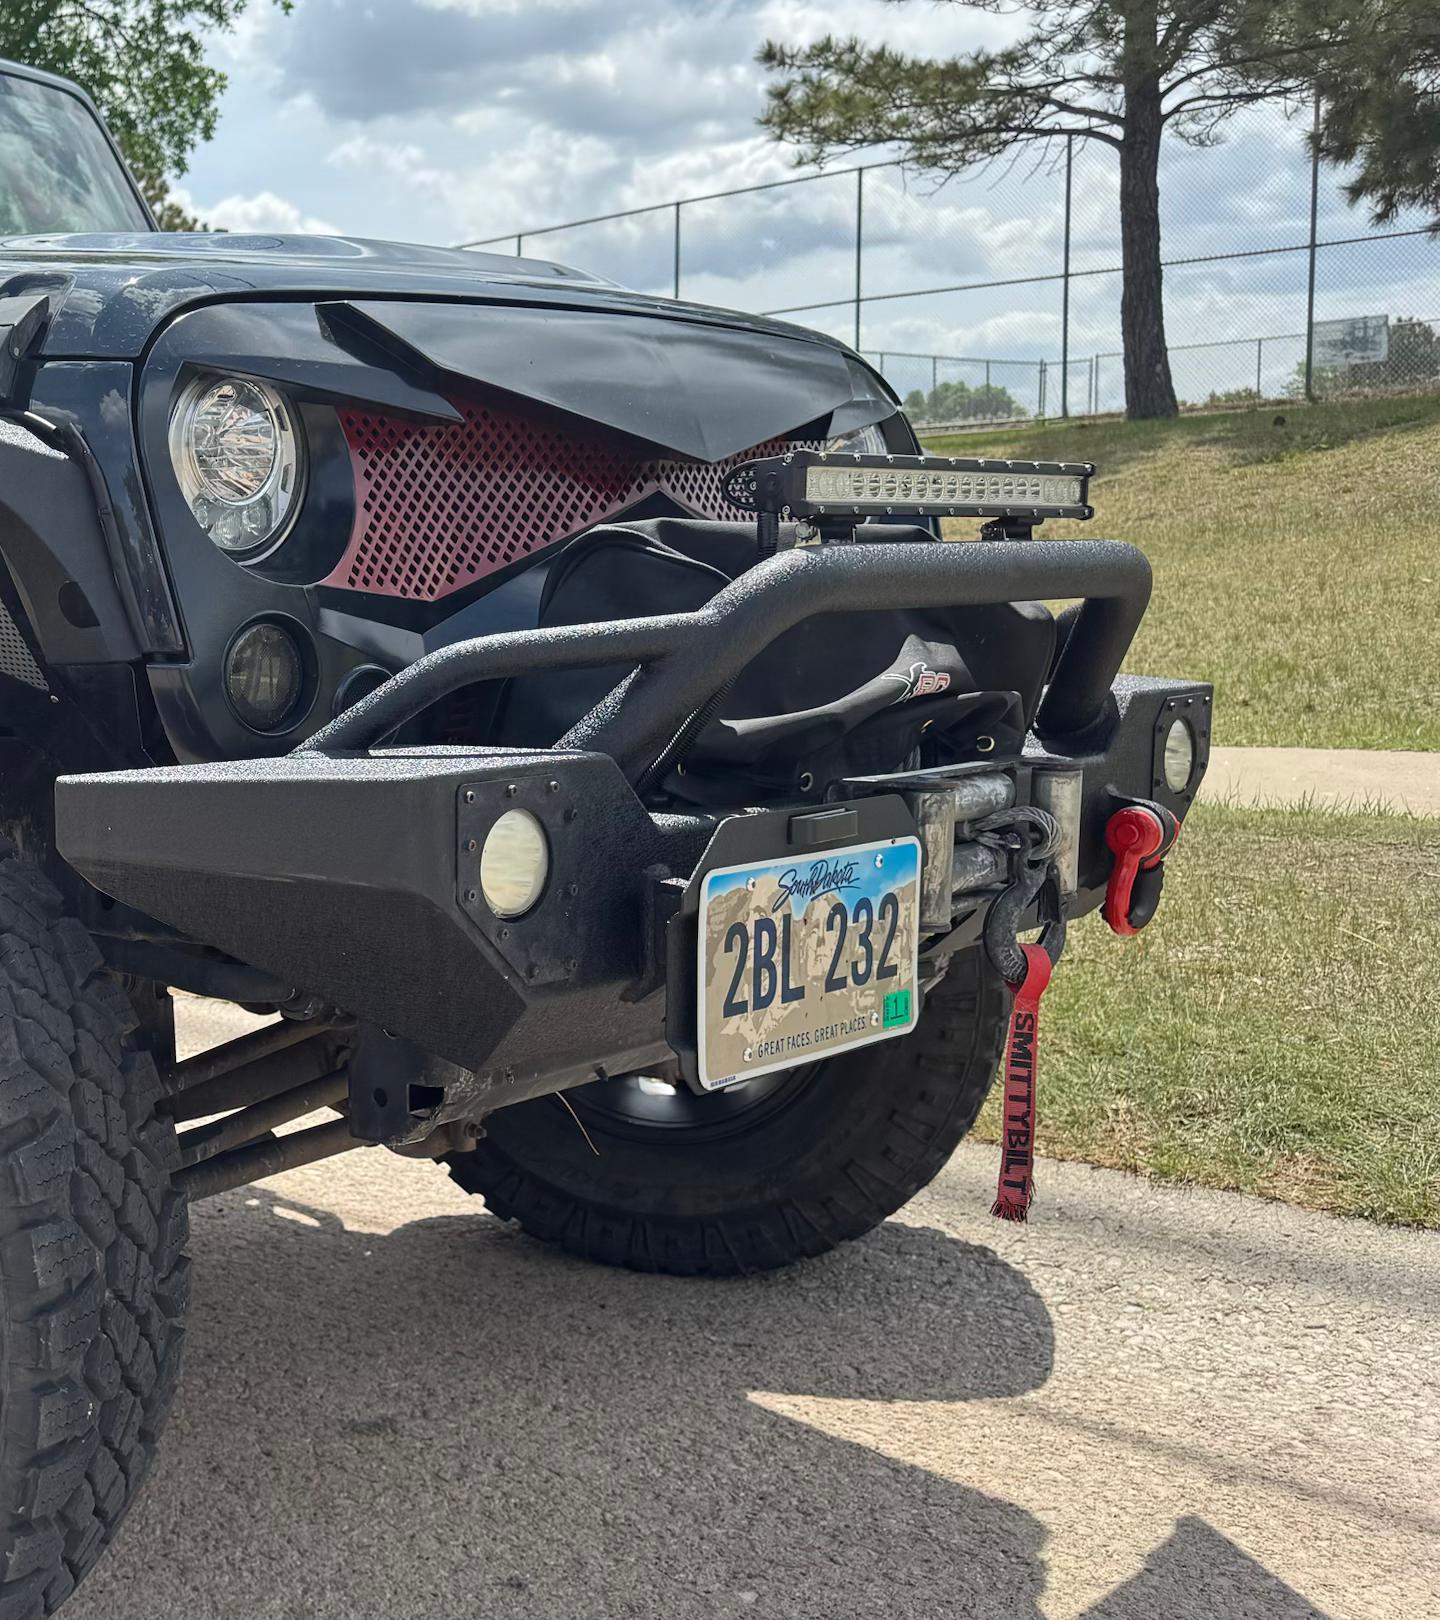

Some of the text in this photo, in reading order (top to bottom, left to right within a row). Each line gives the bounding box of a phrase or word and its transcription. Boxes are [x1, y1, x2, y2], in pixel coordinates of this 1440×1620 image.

[722, 891, 900, 1019] 2BL 232
[757, 1016, 867, 1058] GREAT FACES. GREAT PLACES.
[1003, 1012, 1036, 1196] SMITTYBILT
